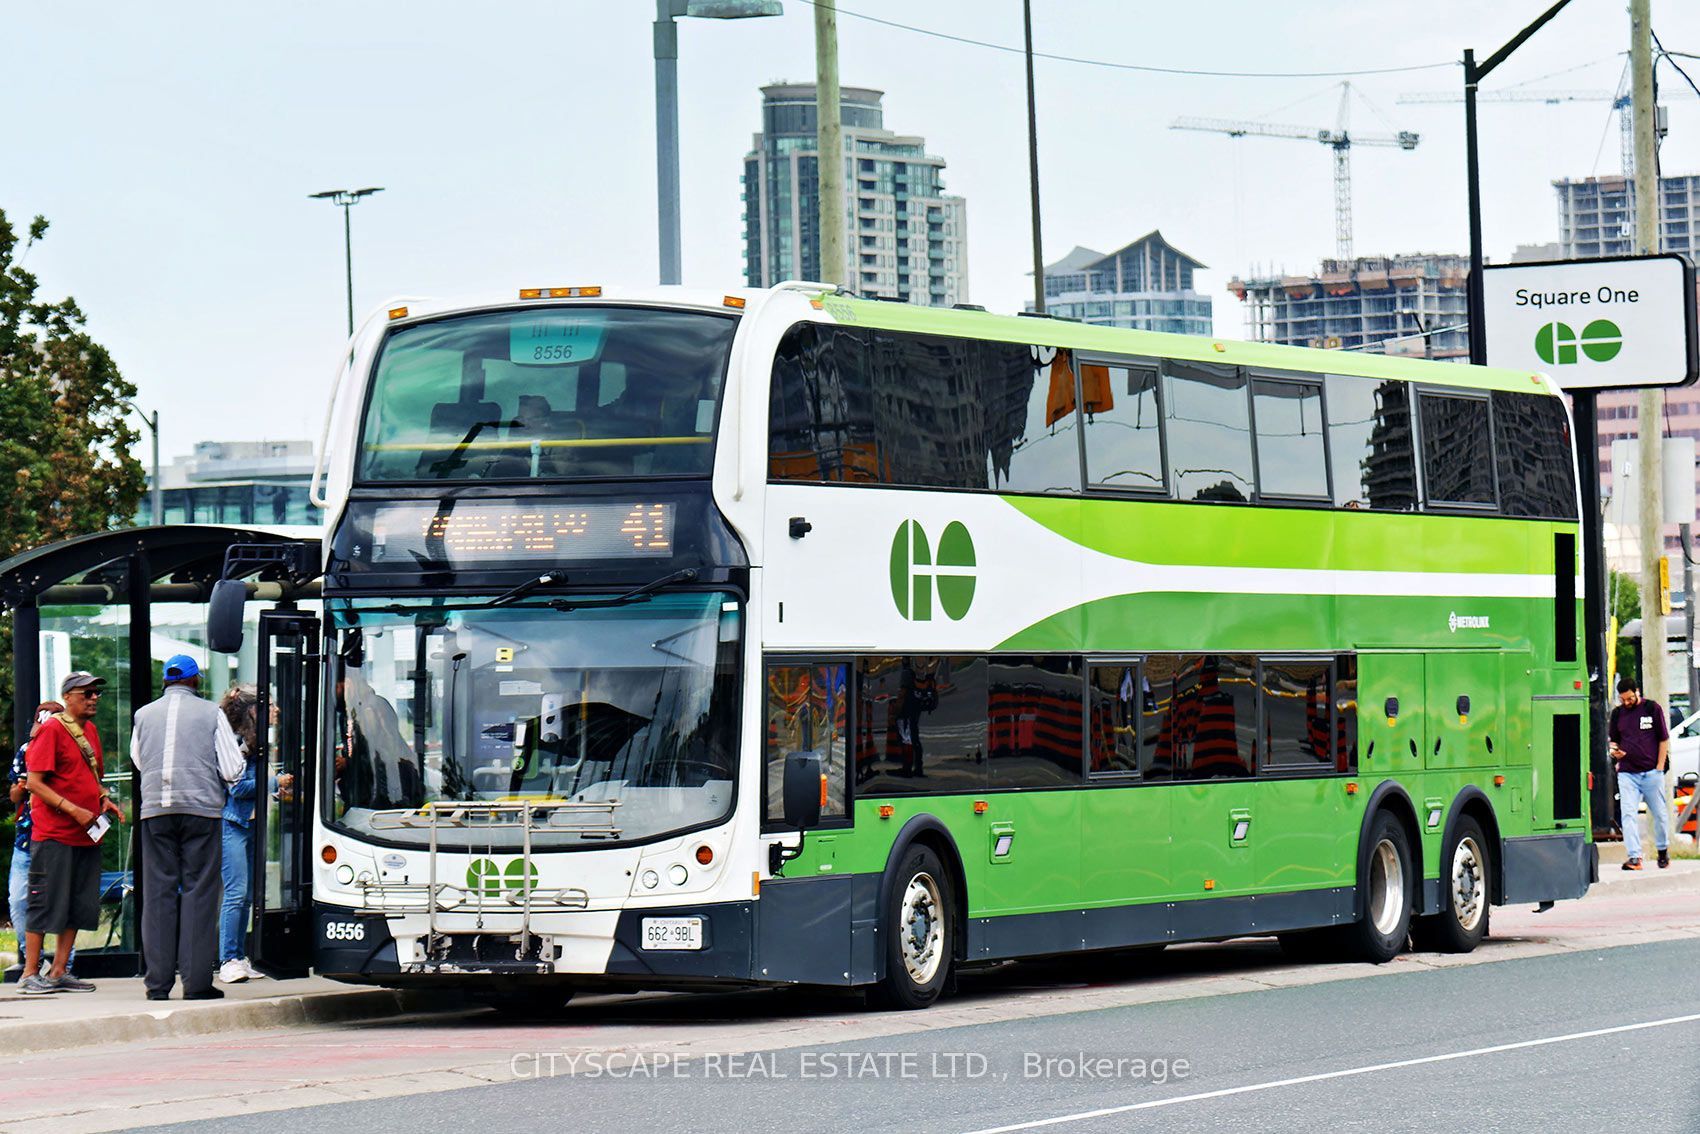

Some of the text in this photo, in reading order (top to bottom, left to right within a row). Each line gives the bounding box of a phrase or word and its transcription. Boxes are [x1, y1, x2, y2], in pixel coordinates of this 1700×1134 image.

[1515, 287, 1638, 308] Square One
[533, 344, 573, 361] 8556
[1535, 319, 1621, 365] GO
[621, 503, 669, 548] 41
[891, 521, 976, 621] GO
[466, 858, 538, 897] GO
[326, 921, 365, 941] 8556
[648, 926, 695, 941] 662 9BL
